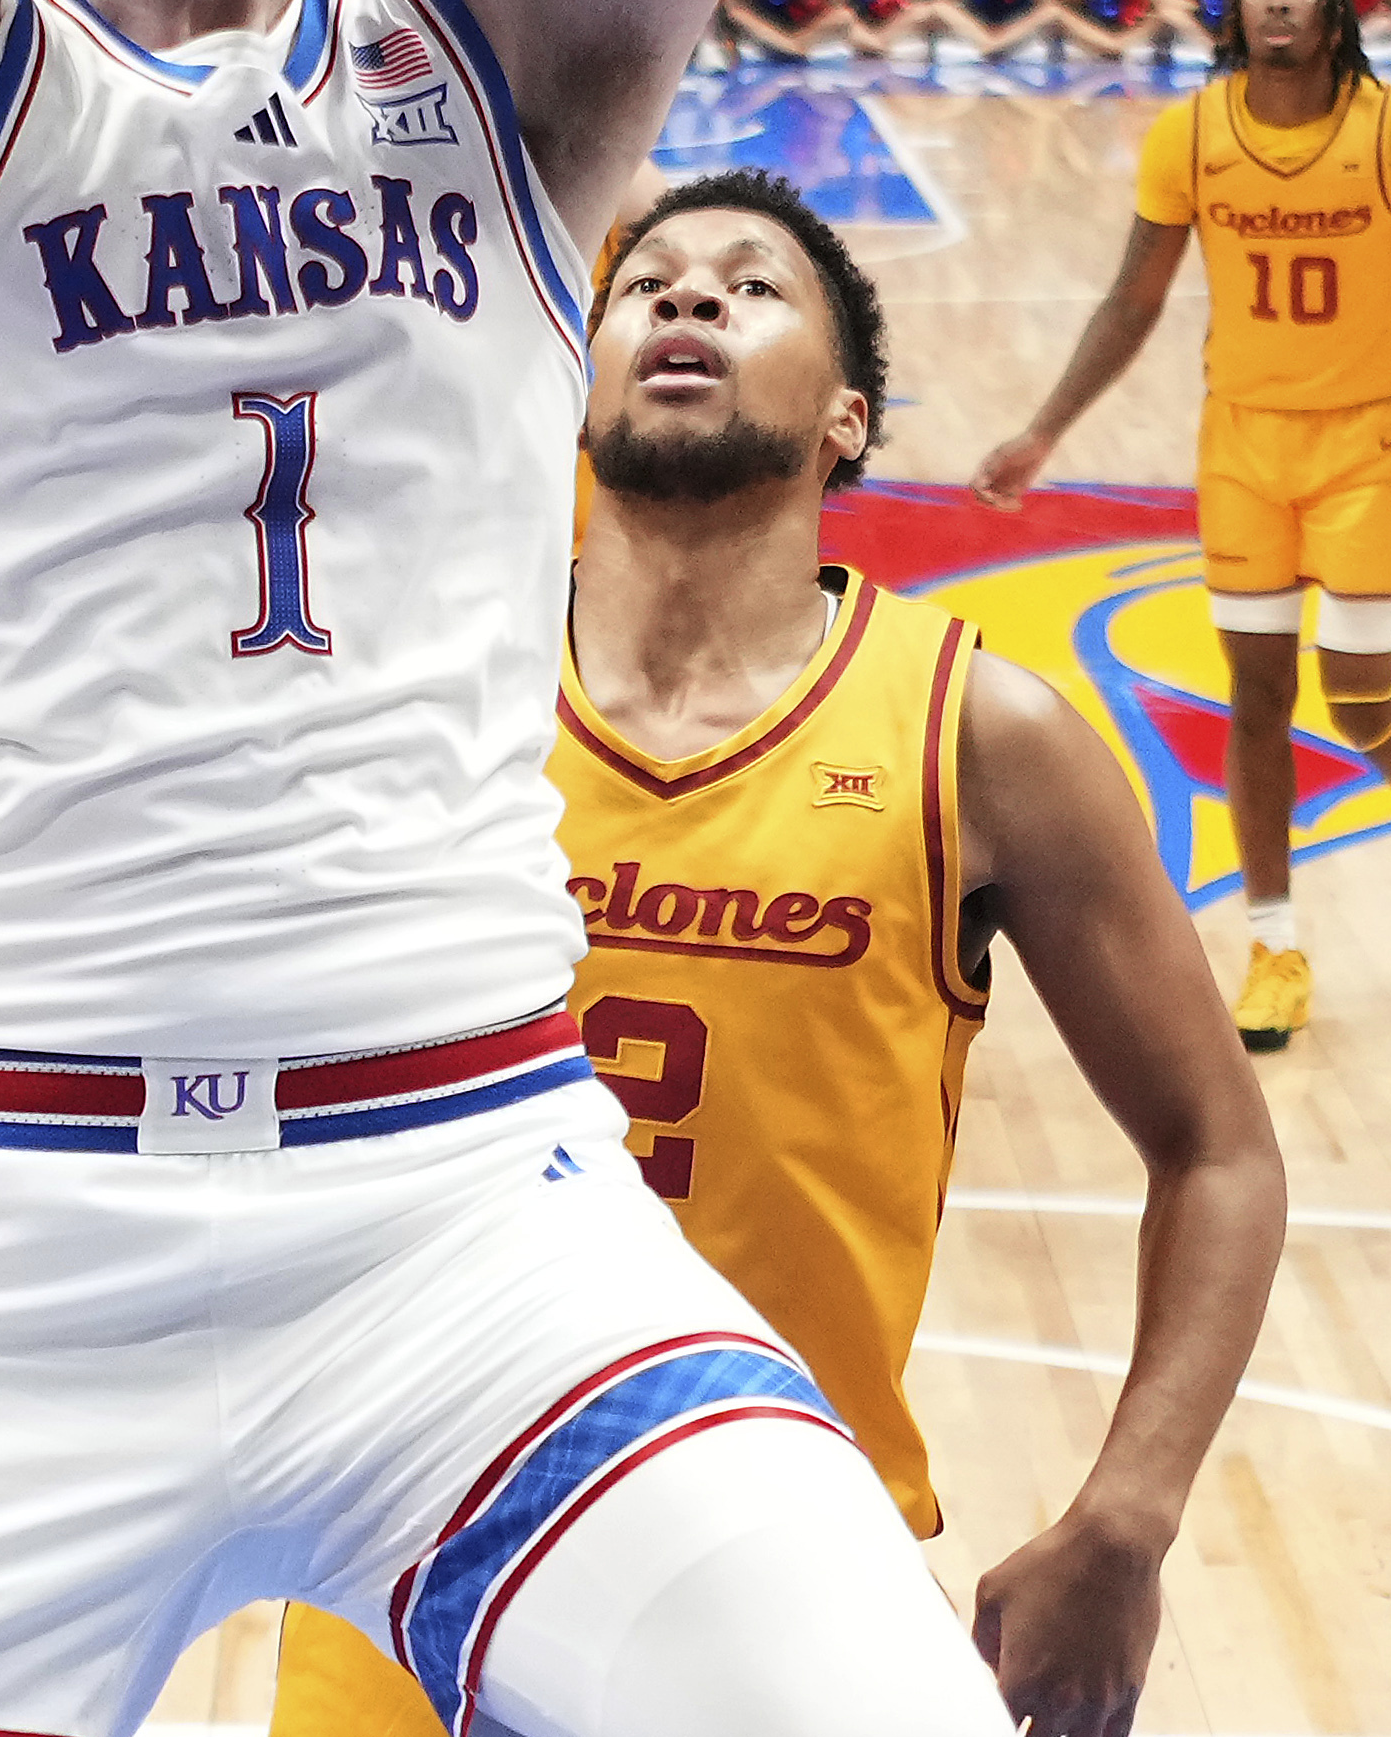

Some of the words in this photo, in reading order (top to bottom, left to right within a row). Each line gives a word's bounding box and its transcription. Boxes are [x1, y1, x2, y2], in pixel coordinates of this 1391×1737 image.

[1209, 203, 1372, 240] Cyclones
[23, 174, 480, 354] KANSAS
[1247, 252, 1340, 326] 10
[231, 391, 333, 658] 1
[169, 1070, 250, 1121] KU
